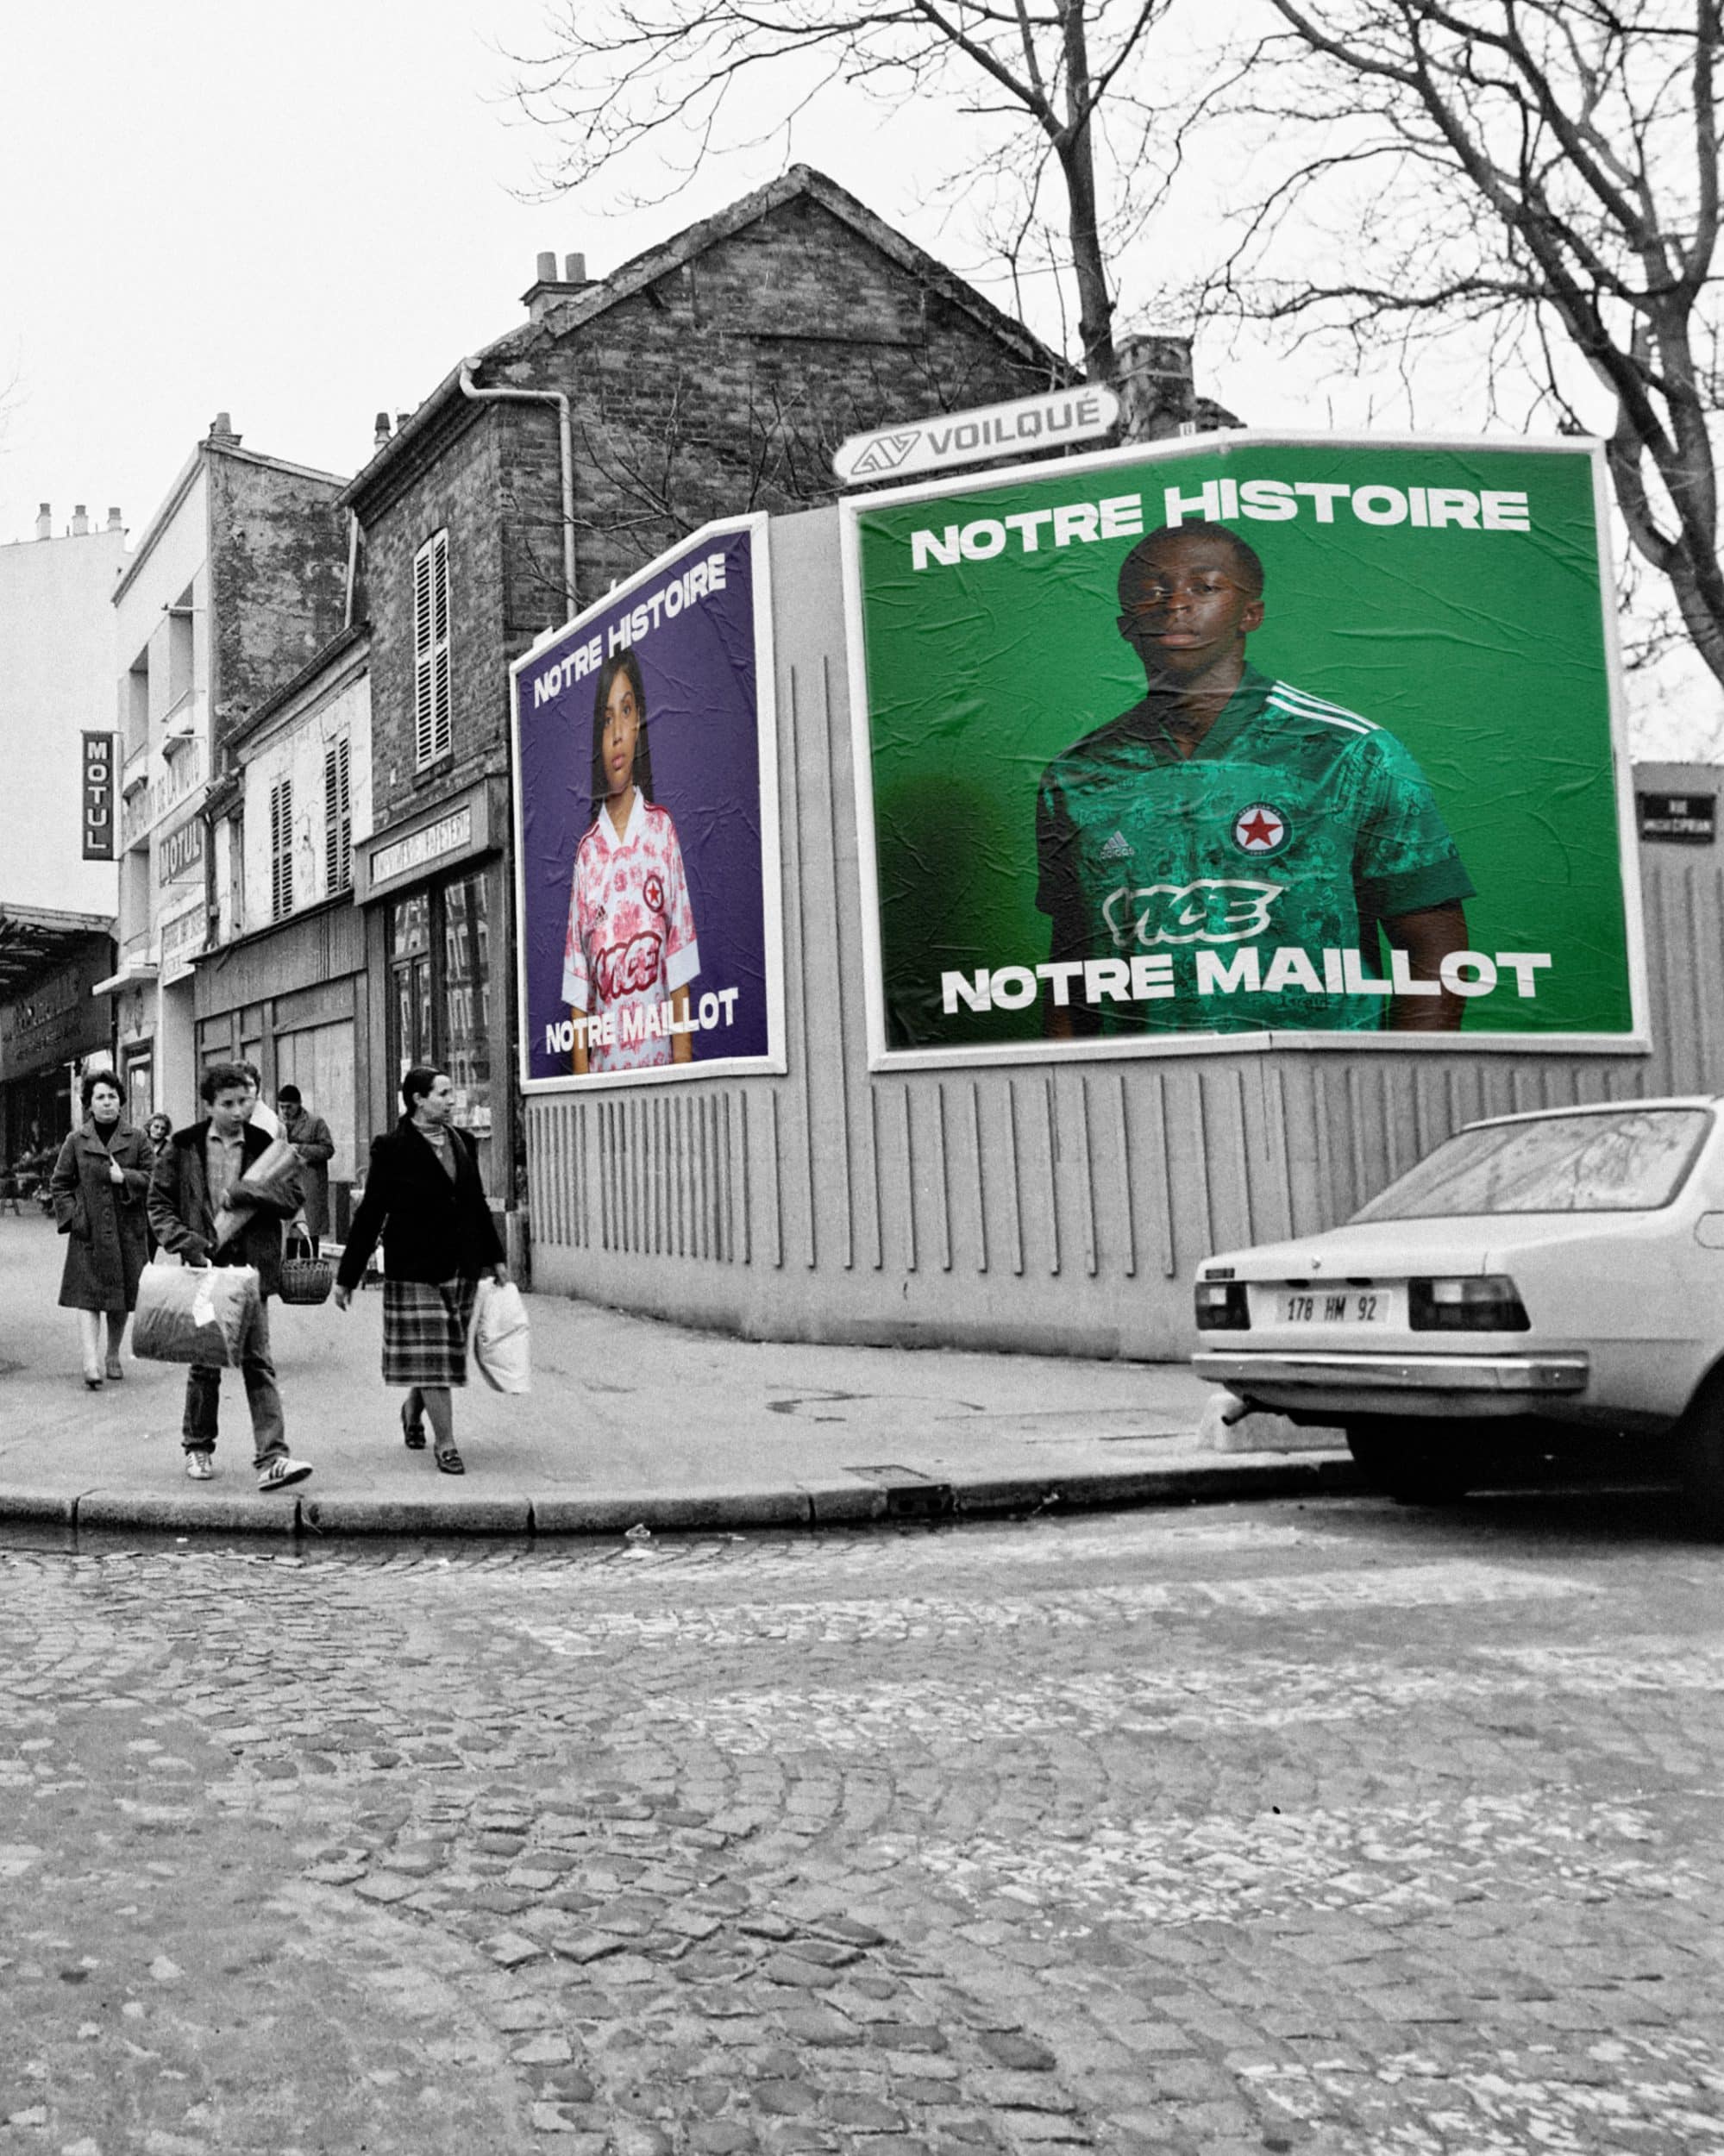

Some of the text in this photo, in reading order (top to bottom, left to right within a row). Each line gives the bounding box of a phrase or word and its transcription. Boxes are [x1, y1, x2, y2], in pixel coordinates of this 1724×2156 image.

[927, 392, 1100, 455] VOILQUÉ
[911, 479, 1531, 571] NOTRE HISTOIRE
[534, 553, 726, 709] NOTRE HISTOIRE
[87, 741, 108, 849] MOTUL
[160, 820, 201, 883] MOTUL
[941, 947, 1552, 1014] NOTRE MAILLOT
[546, 987, 739, 1055] NOTRE MAILLOT
[1288, 1295, 1376, 1321] 178 HM 92
